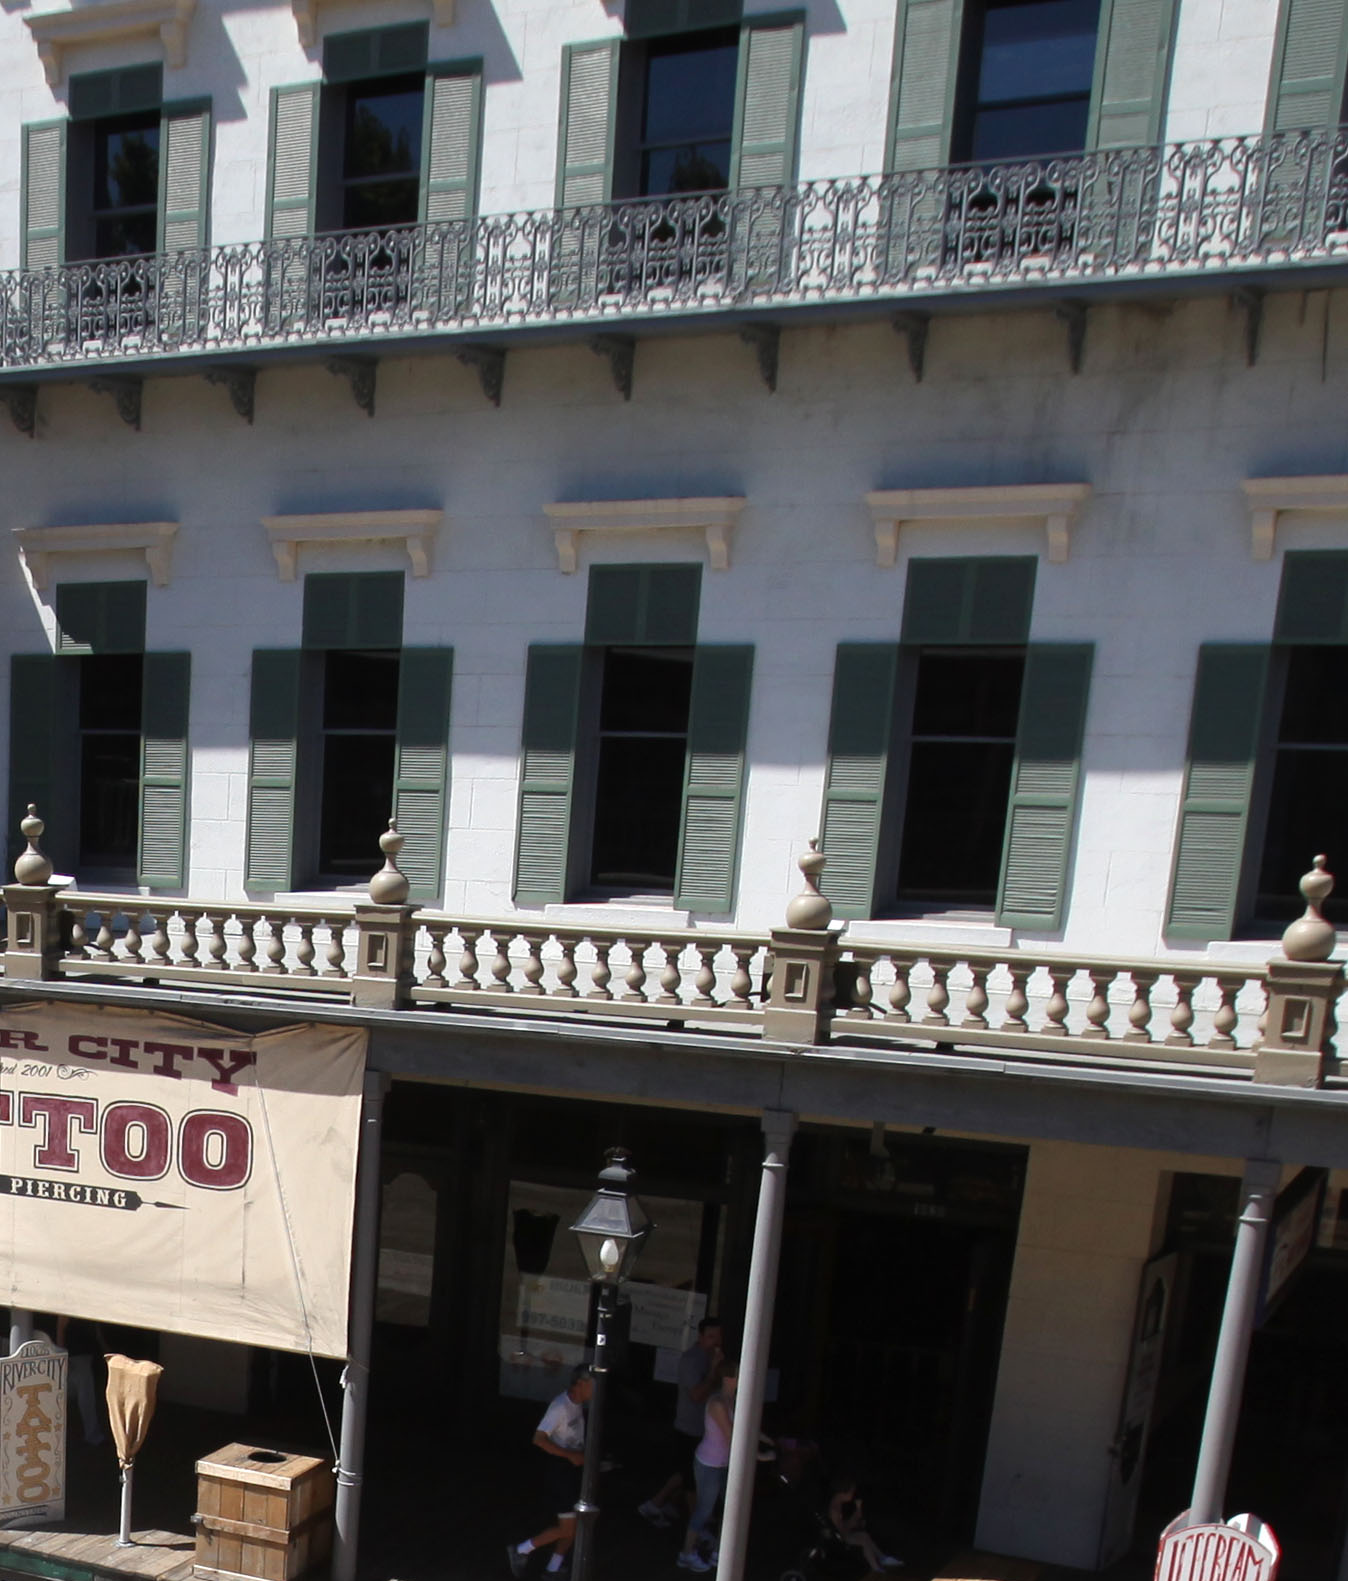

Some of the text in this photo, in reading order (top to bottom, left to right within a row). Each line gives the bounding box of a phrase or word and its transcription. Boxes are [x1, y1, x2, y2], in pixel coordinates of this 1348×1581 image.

[20, 1063, 52, 1077] 2001
[67, 1034, 257, 1096] CITY
[10, 1177, 127, 1207] PIERCING
[16, 1383, 53, 1503] TATTOO
